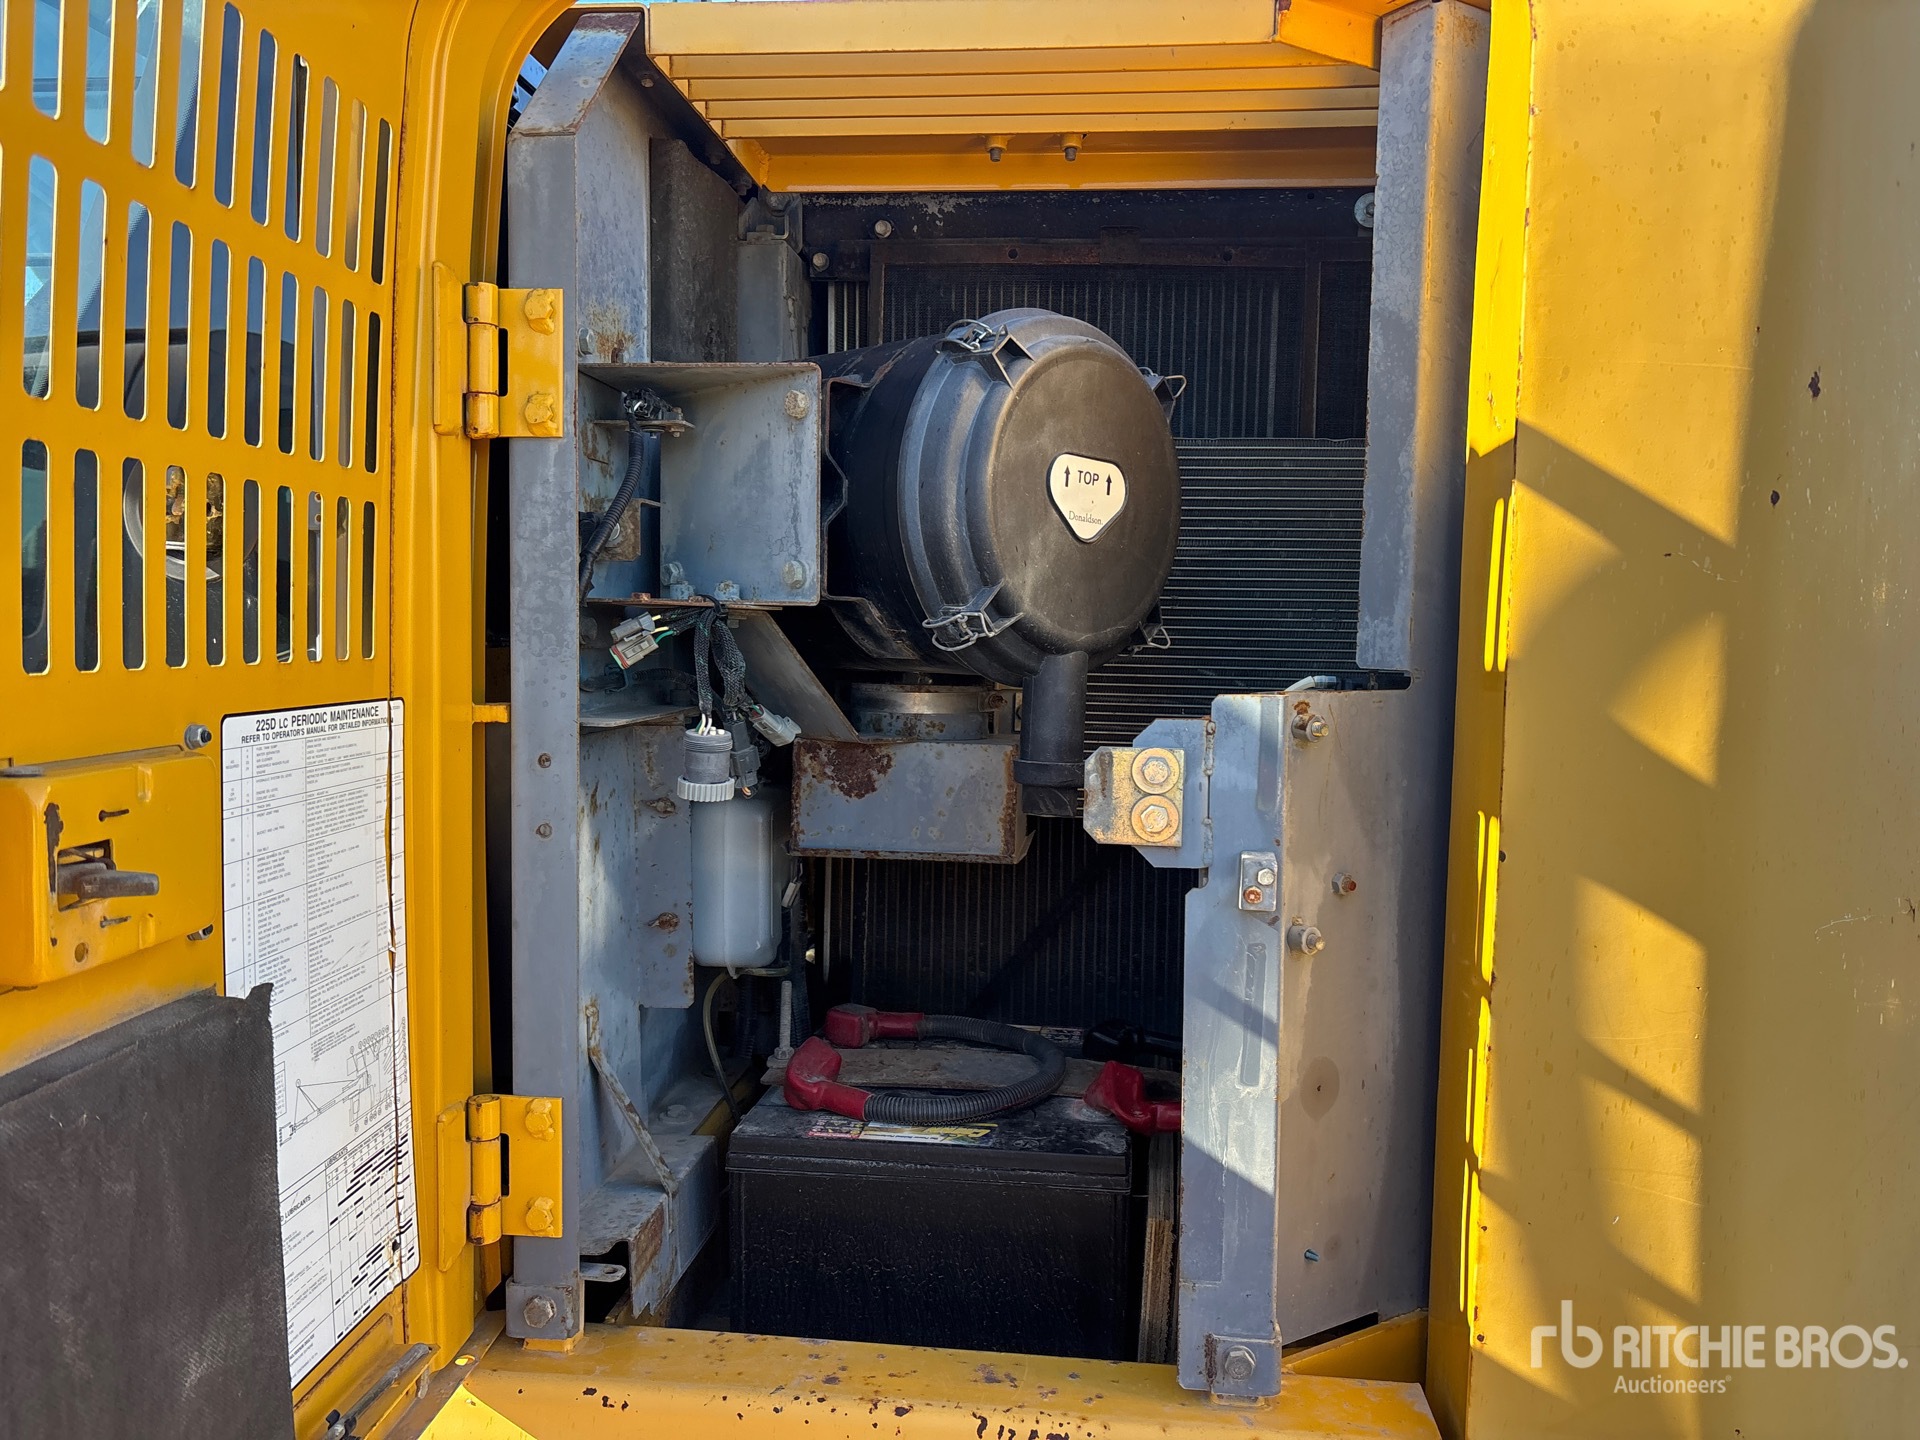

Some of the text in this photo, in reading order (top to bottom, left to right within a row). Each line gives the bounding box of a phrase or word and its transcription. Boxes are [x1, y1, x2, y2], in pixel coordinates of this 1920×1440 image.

[1078, 470, 1100, 486] TOP
[256, 718, 276, 731] 225D
[279, 718, 289, 729] LC
[291, 711, 327, 728] PERIODIC
[330, 706, 379, 722] MAINTENANCE
[241, 734, 260, 744] REFER
[262, 732, 270, 741] TO
[272, 728, 305, 740] OPERATOR'S
[306, 724, 327, 735] MANUAL
[328, 723, 338, 732] FOR
[339, 720, 361, 731] DETAILED
[324, 1146, 349, 1168] LUBRICANTS
[284, 1194, 311, 1219] LUBRICANTS
